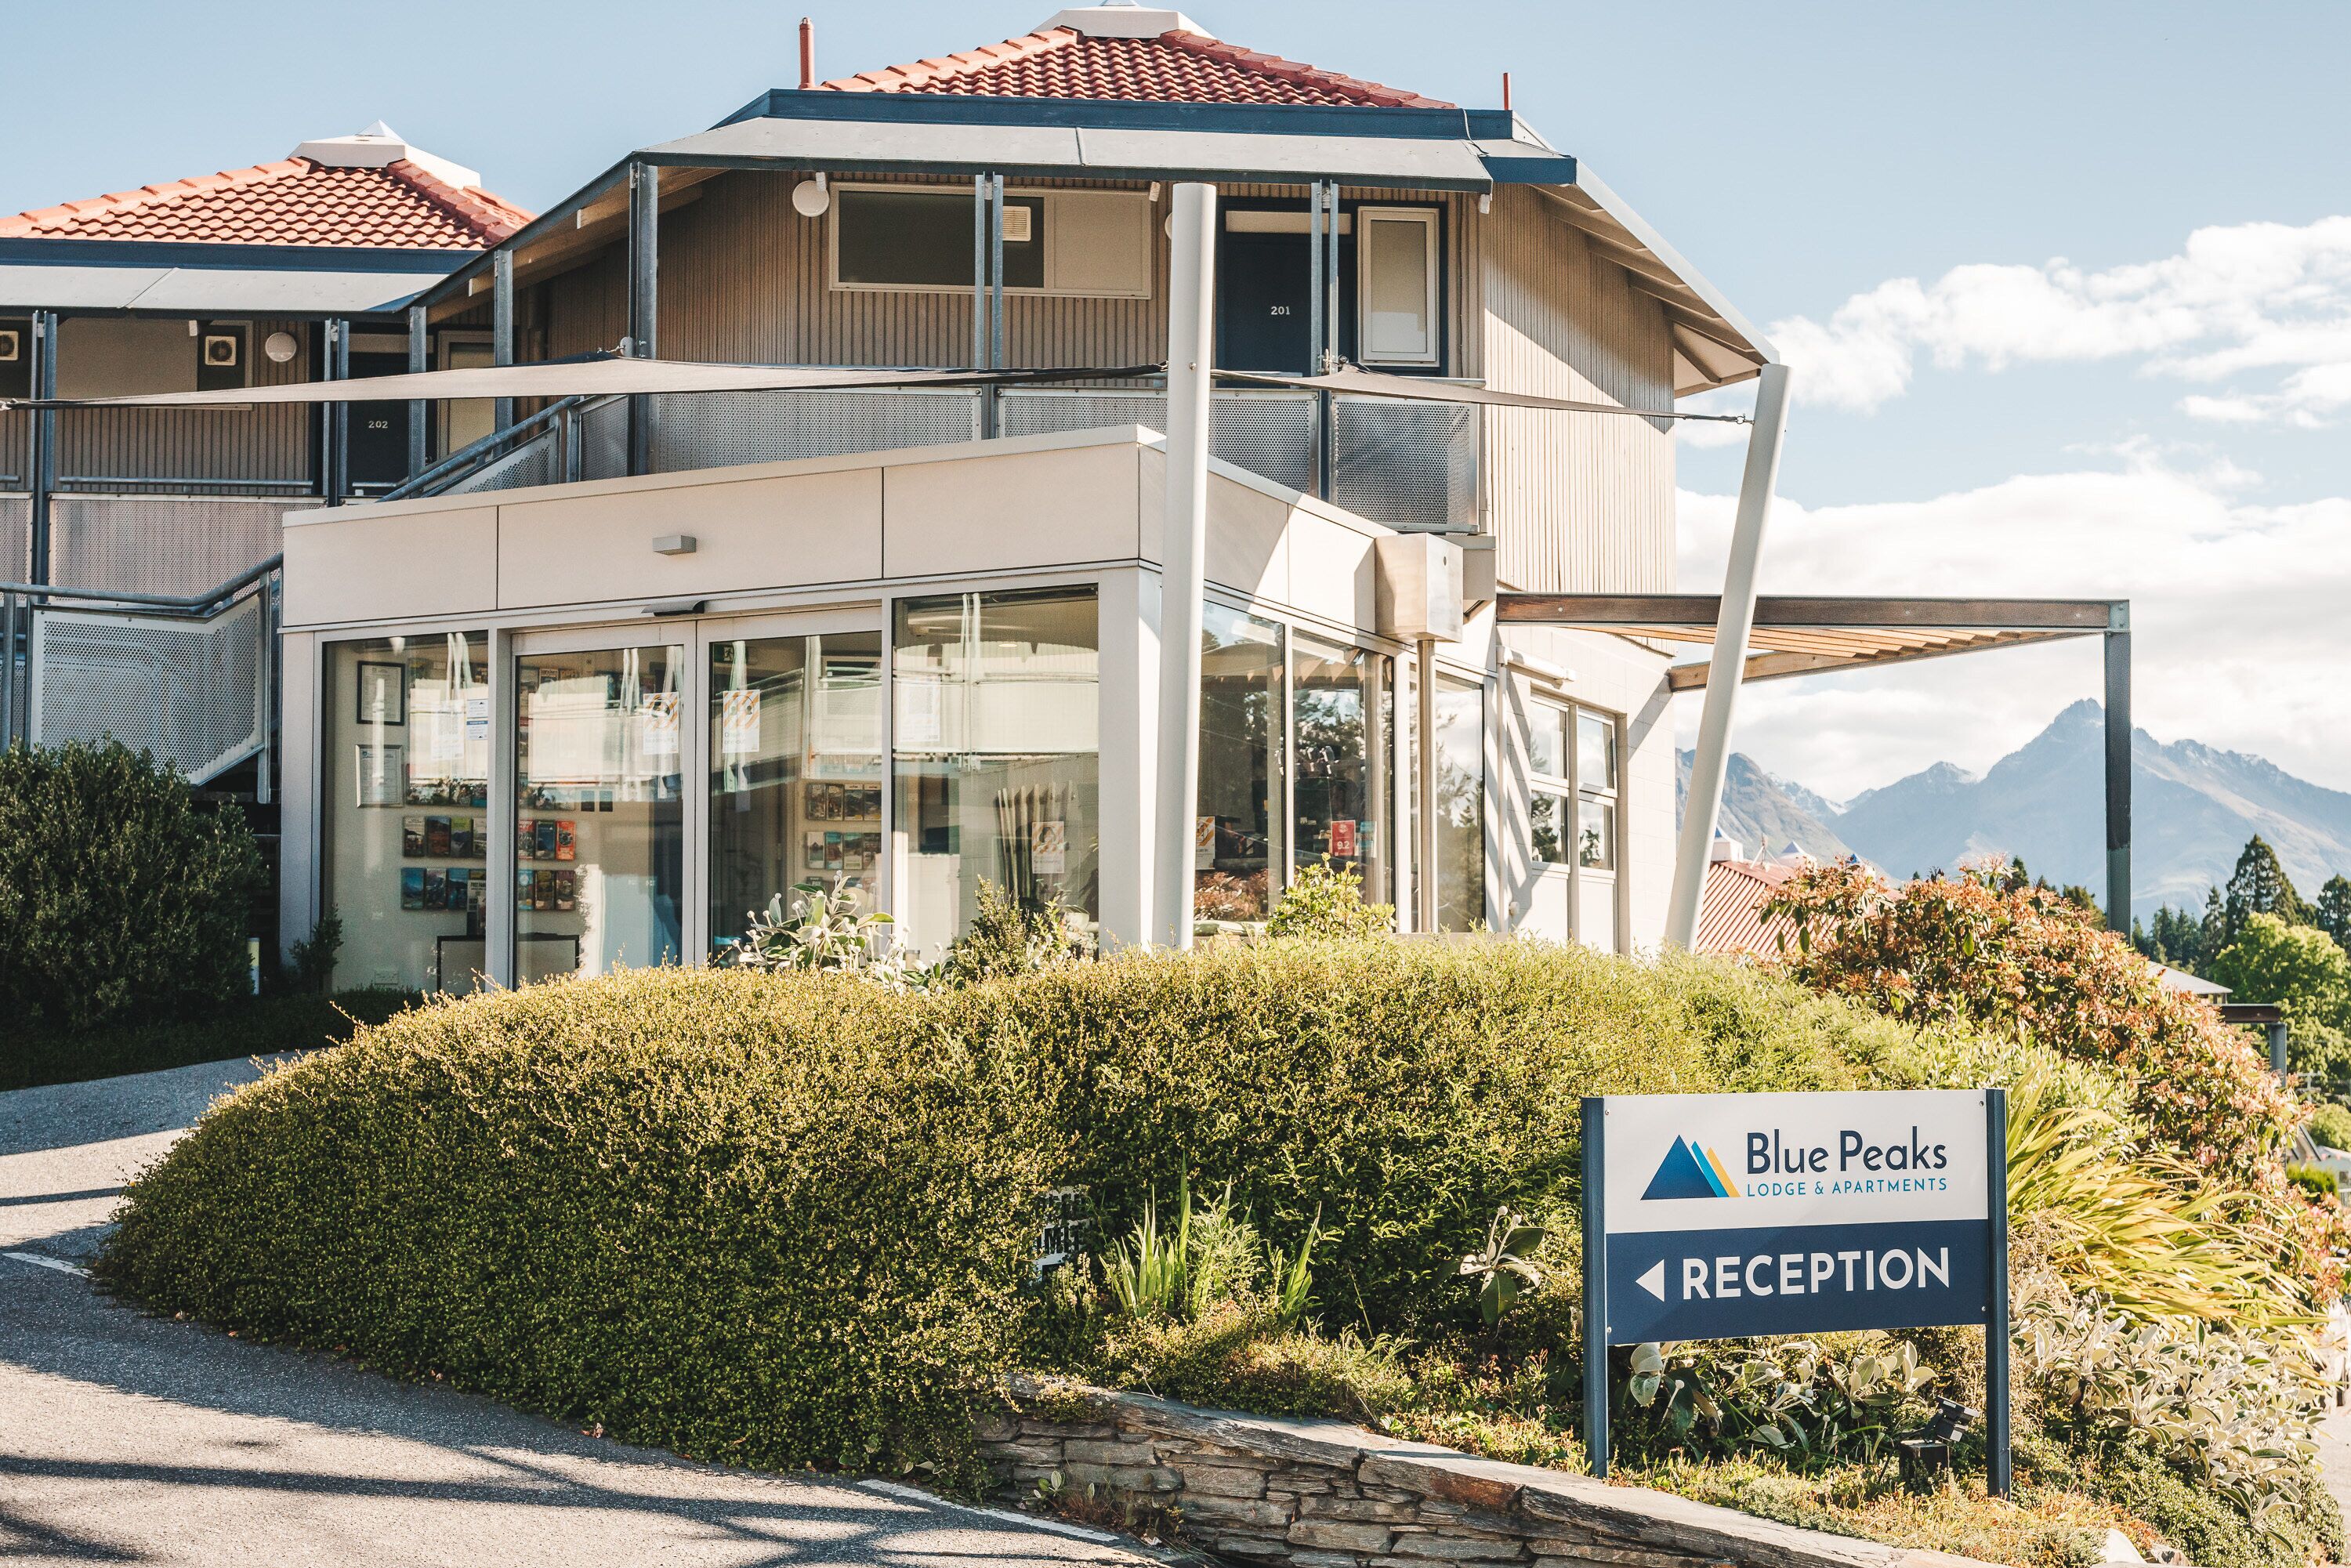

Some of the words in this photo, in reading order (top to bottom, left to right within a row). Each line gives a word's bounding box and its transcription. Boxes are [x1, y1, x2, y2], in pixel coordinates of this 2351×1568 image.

[1270, 306, 1291, 315] 201
[368, 420, 388, 429] 202
[1337, 840, 1350, 850] 9.2
[1747, 1128, 1829, 1175] Blue
[1839, 1125, 1947, 1172] Peaks
[1747, 1182, 1806, 1197] LODGE
[1814, 1181, 1824, 1195] &
[1831, 1177, 1947, 1194] APARTMENTS
[1683, 1247, 1950, 1300] RECEPTION
